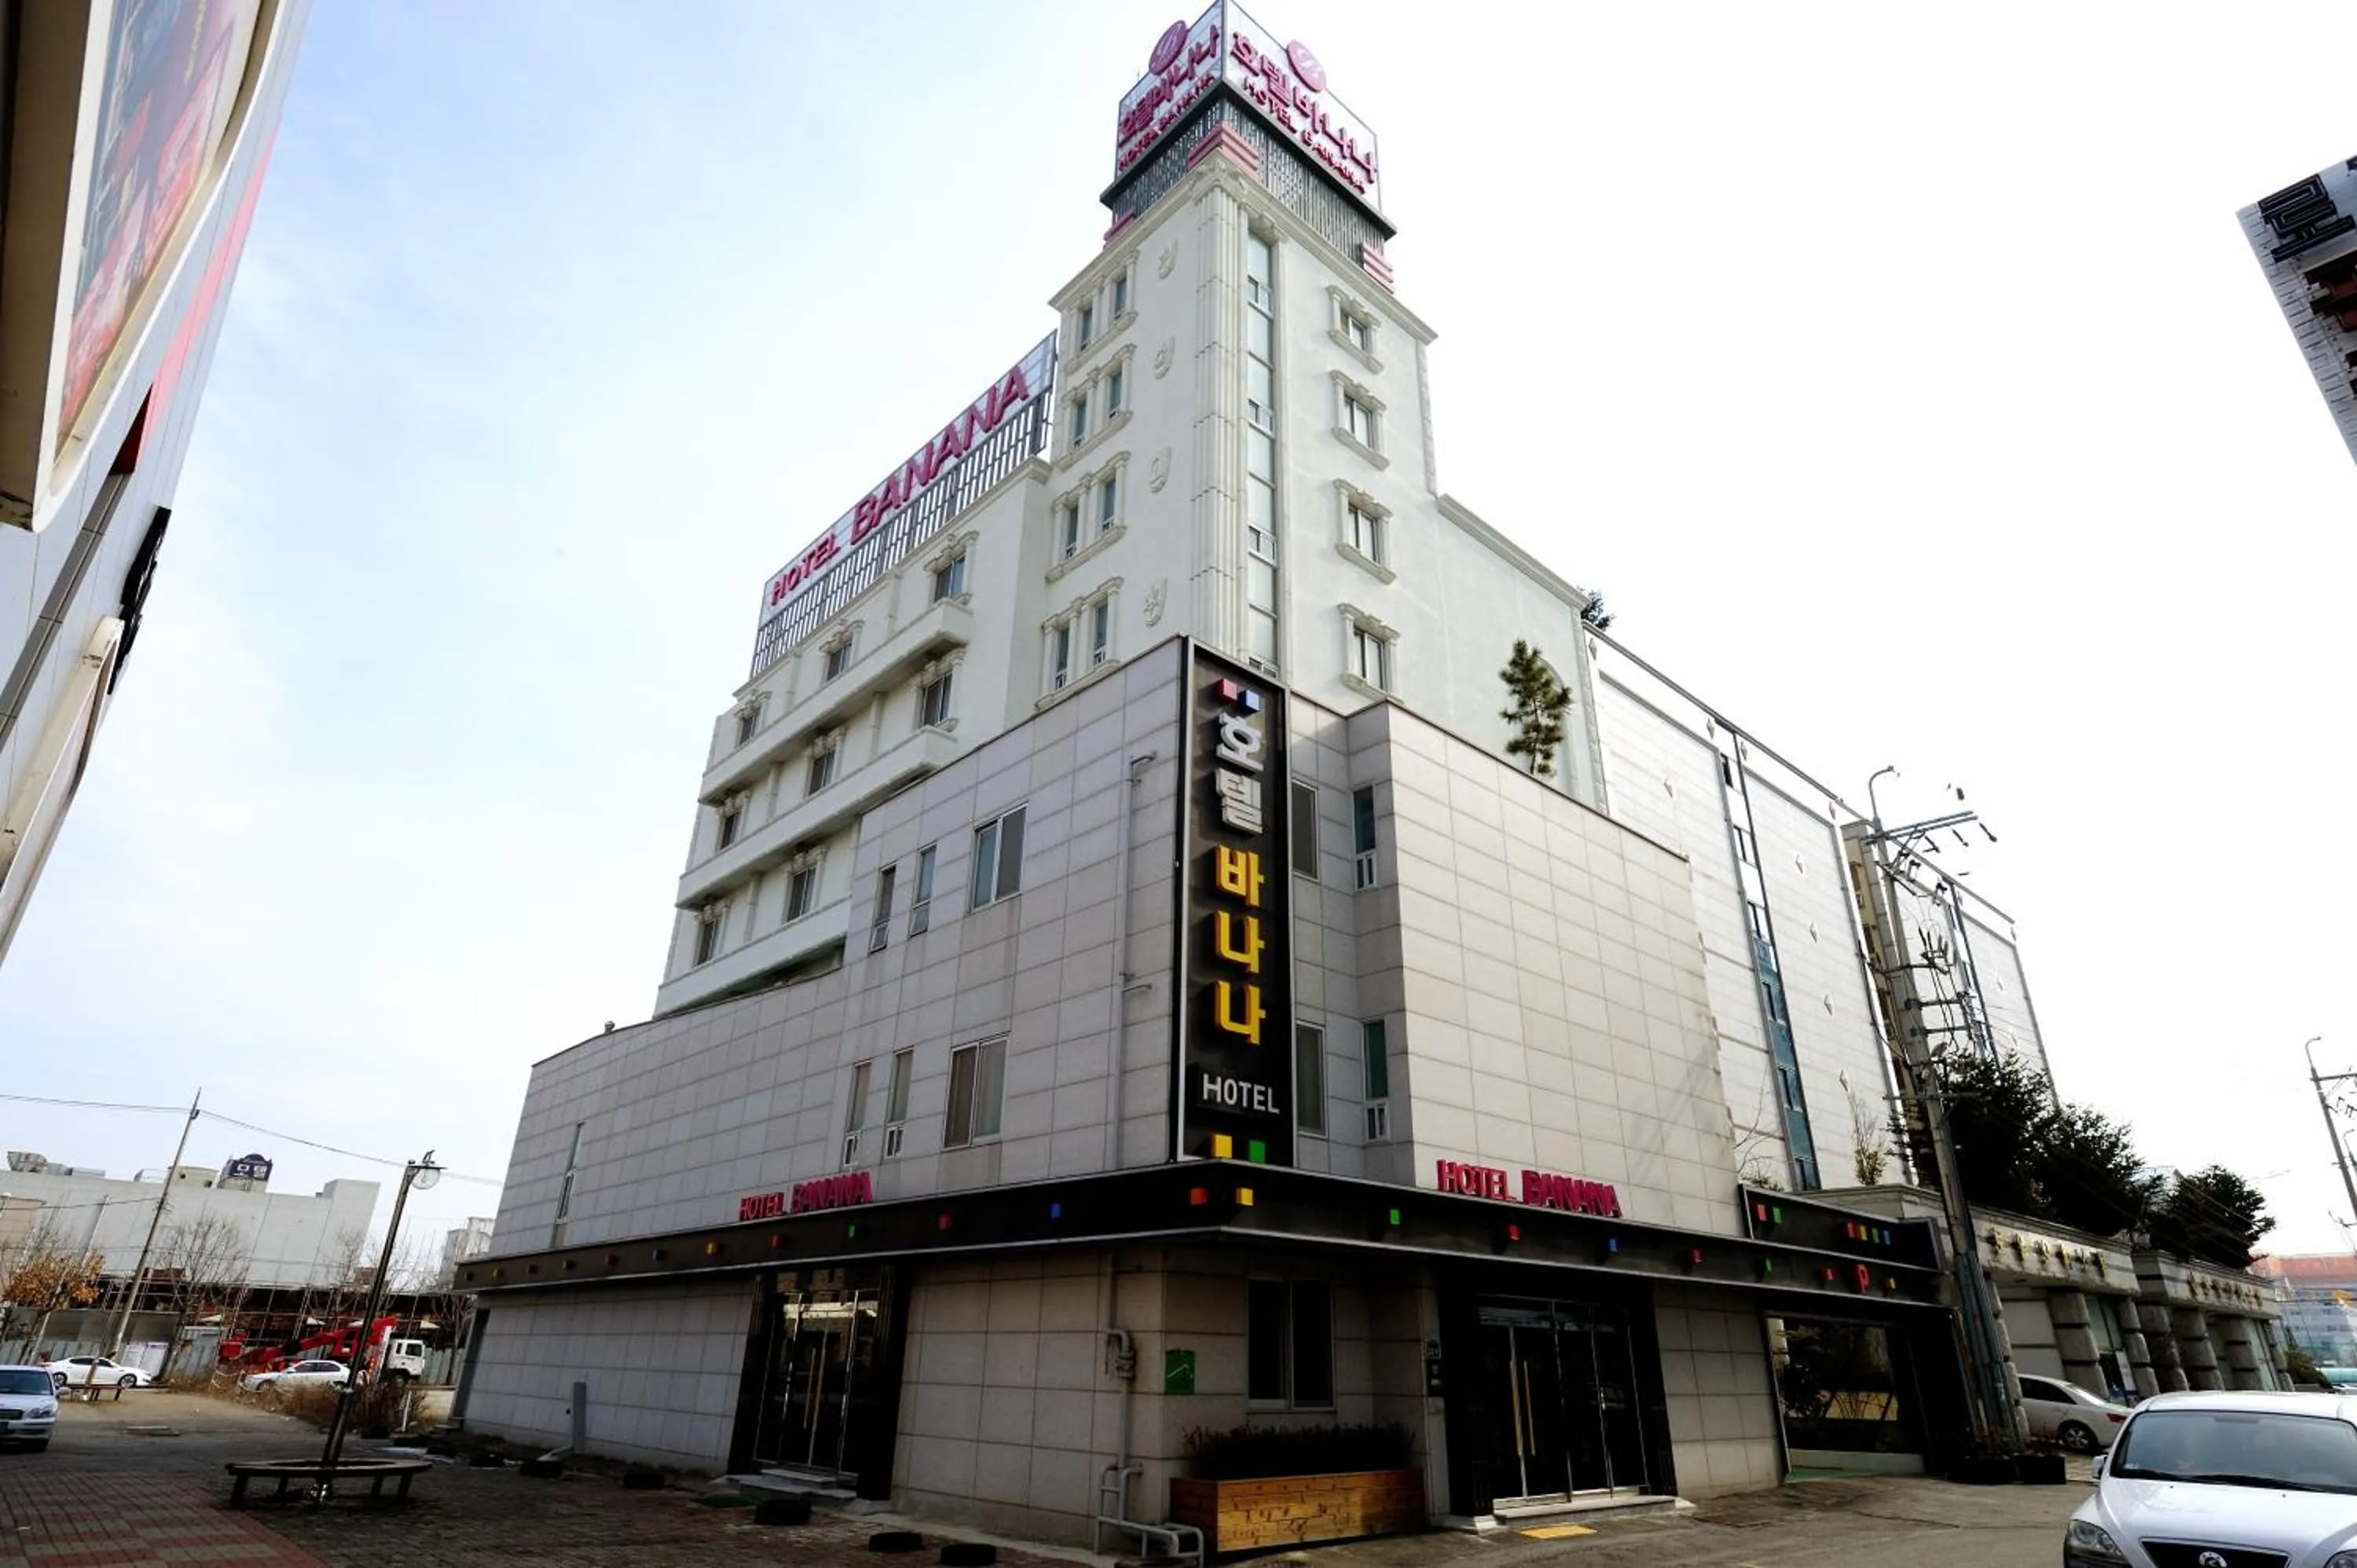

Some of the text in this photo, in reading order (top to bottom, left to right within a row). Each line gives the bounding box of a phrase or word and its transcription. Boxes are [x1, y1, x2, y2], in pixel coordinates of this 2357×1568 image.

[1244, 76, 1297, 134] HOTEL
[770, 365, 1029, 606] HOTEL BANANA
[1202, 1073, 1280, 1115] HOTEL
[739, 1171, 874, 1222] HOTEL BANANA
[1436, 1160, 1622, 1218] HOTEL BANANA
